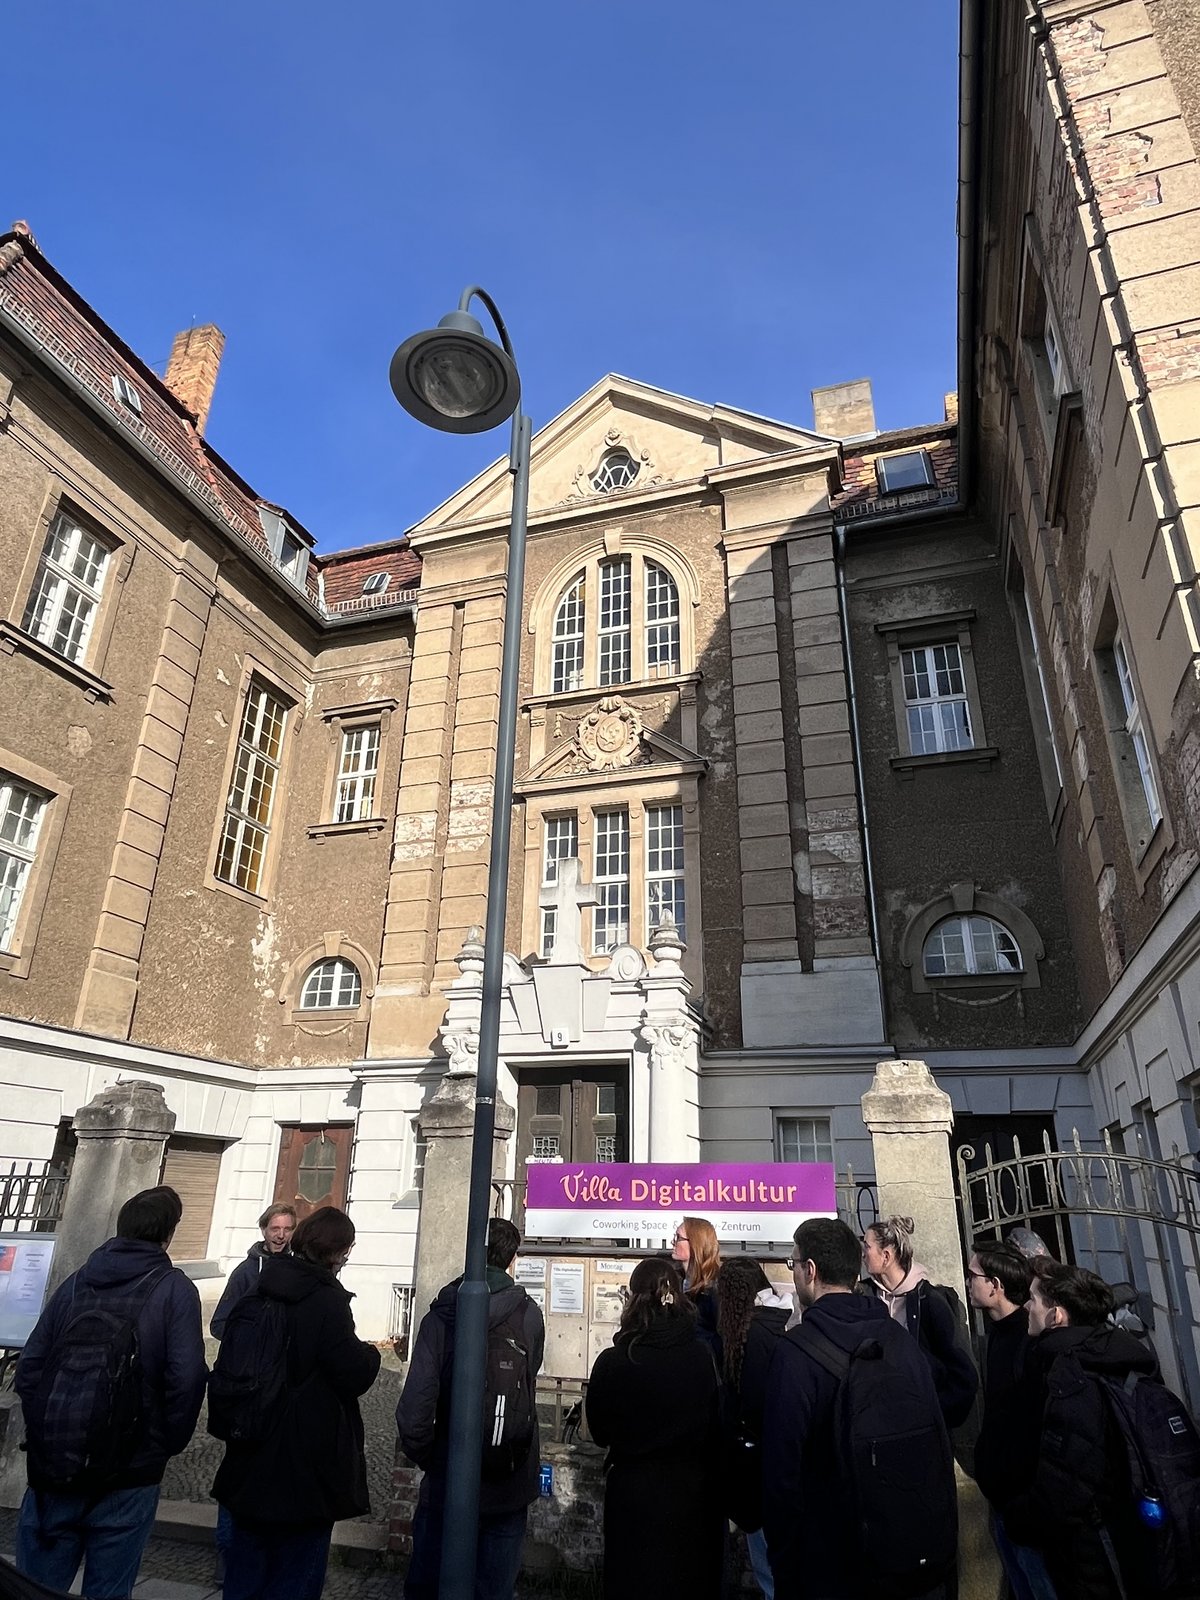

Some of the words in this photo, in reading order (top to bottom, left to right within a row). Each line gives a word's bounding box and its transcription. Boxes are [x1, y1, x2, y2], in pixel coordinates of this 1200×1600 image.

[557, 1032, 563, 1042] 9
[559, 1169, 623, 1203] Villa
[631, 1178, 798, 1207] Digitalkultur
[592, 1218, 640, 1232] Coworking
[641, 1219, 668, 1232] Space
